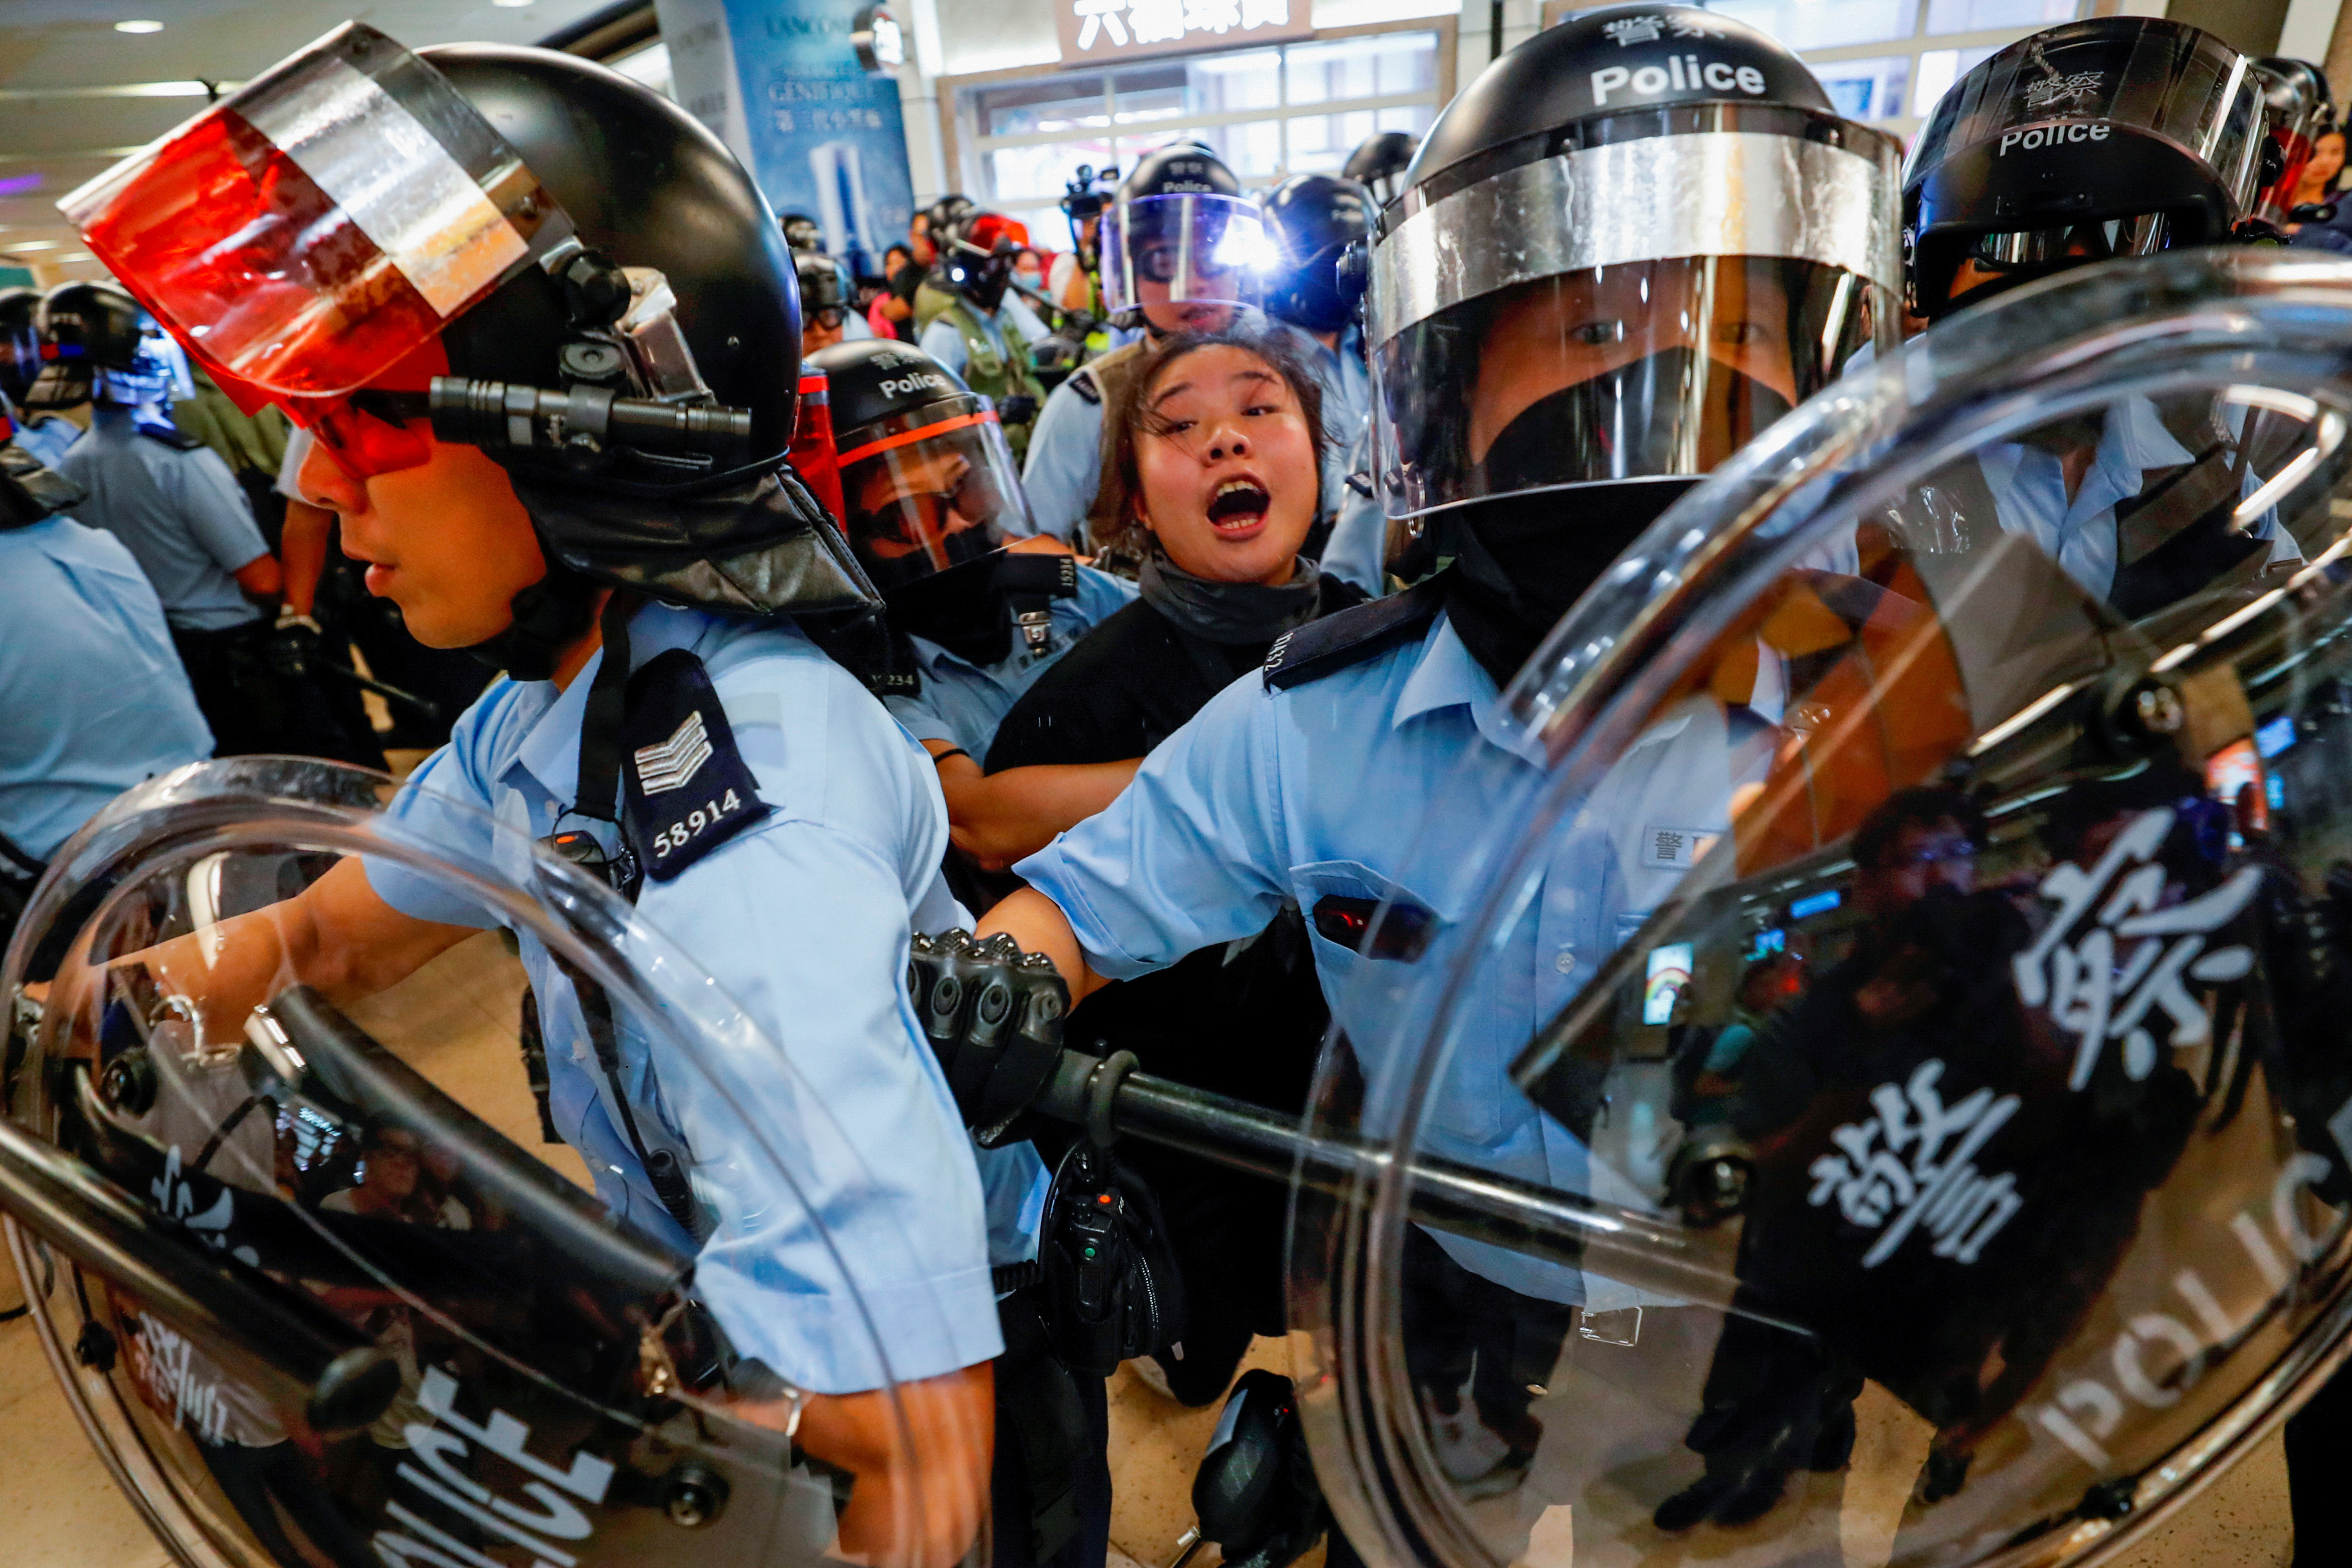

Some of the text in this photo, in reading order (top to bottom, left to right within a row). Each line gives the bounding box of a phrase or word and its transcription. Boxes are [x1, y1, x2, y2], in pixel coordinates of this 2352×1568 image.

[1590, 53, 1766, 106] Police
[2023, 70, 2104, 108] 警察
[1999, 115, 2110, 157] Police
[1163, 181, 1211, 193] Police
[878, 372, 947, 399] Police
[653, 787, 741, 858] 58914
[2039, 1099, 2352, 1469] POLIC
[372, 1364, 616, 1568] LICE
